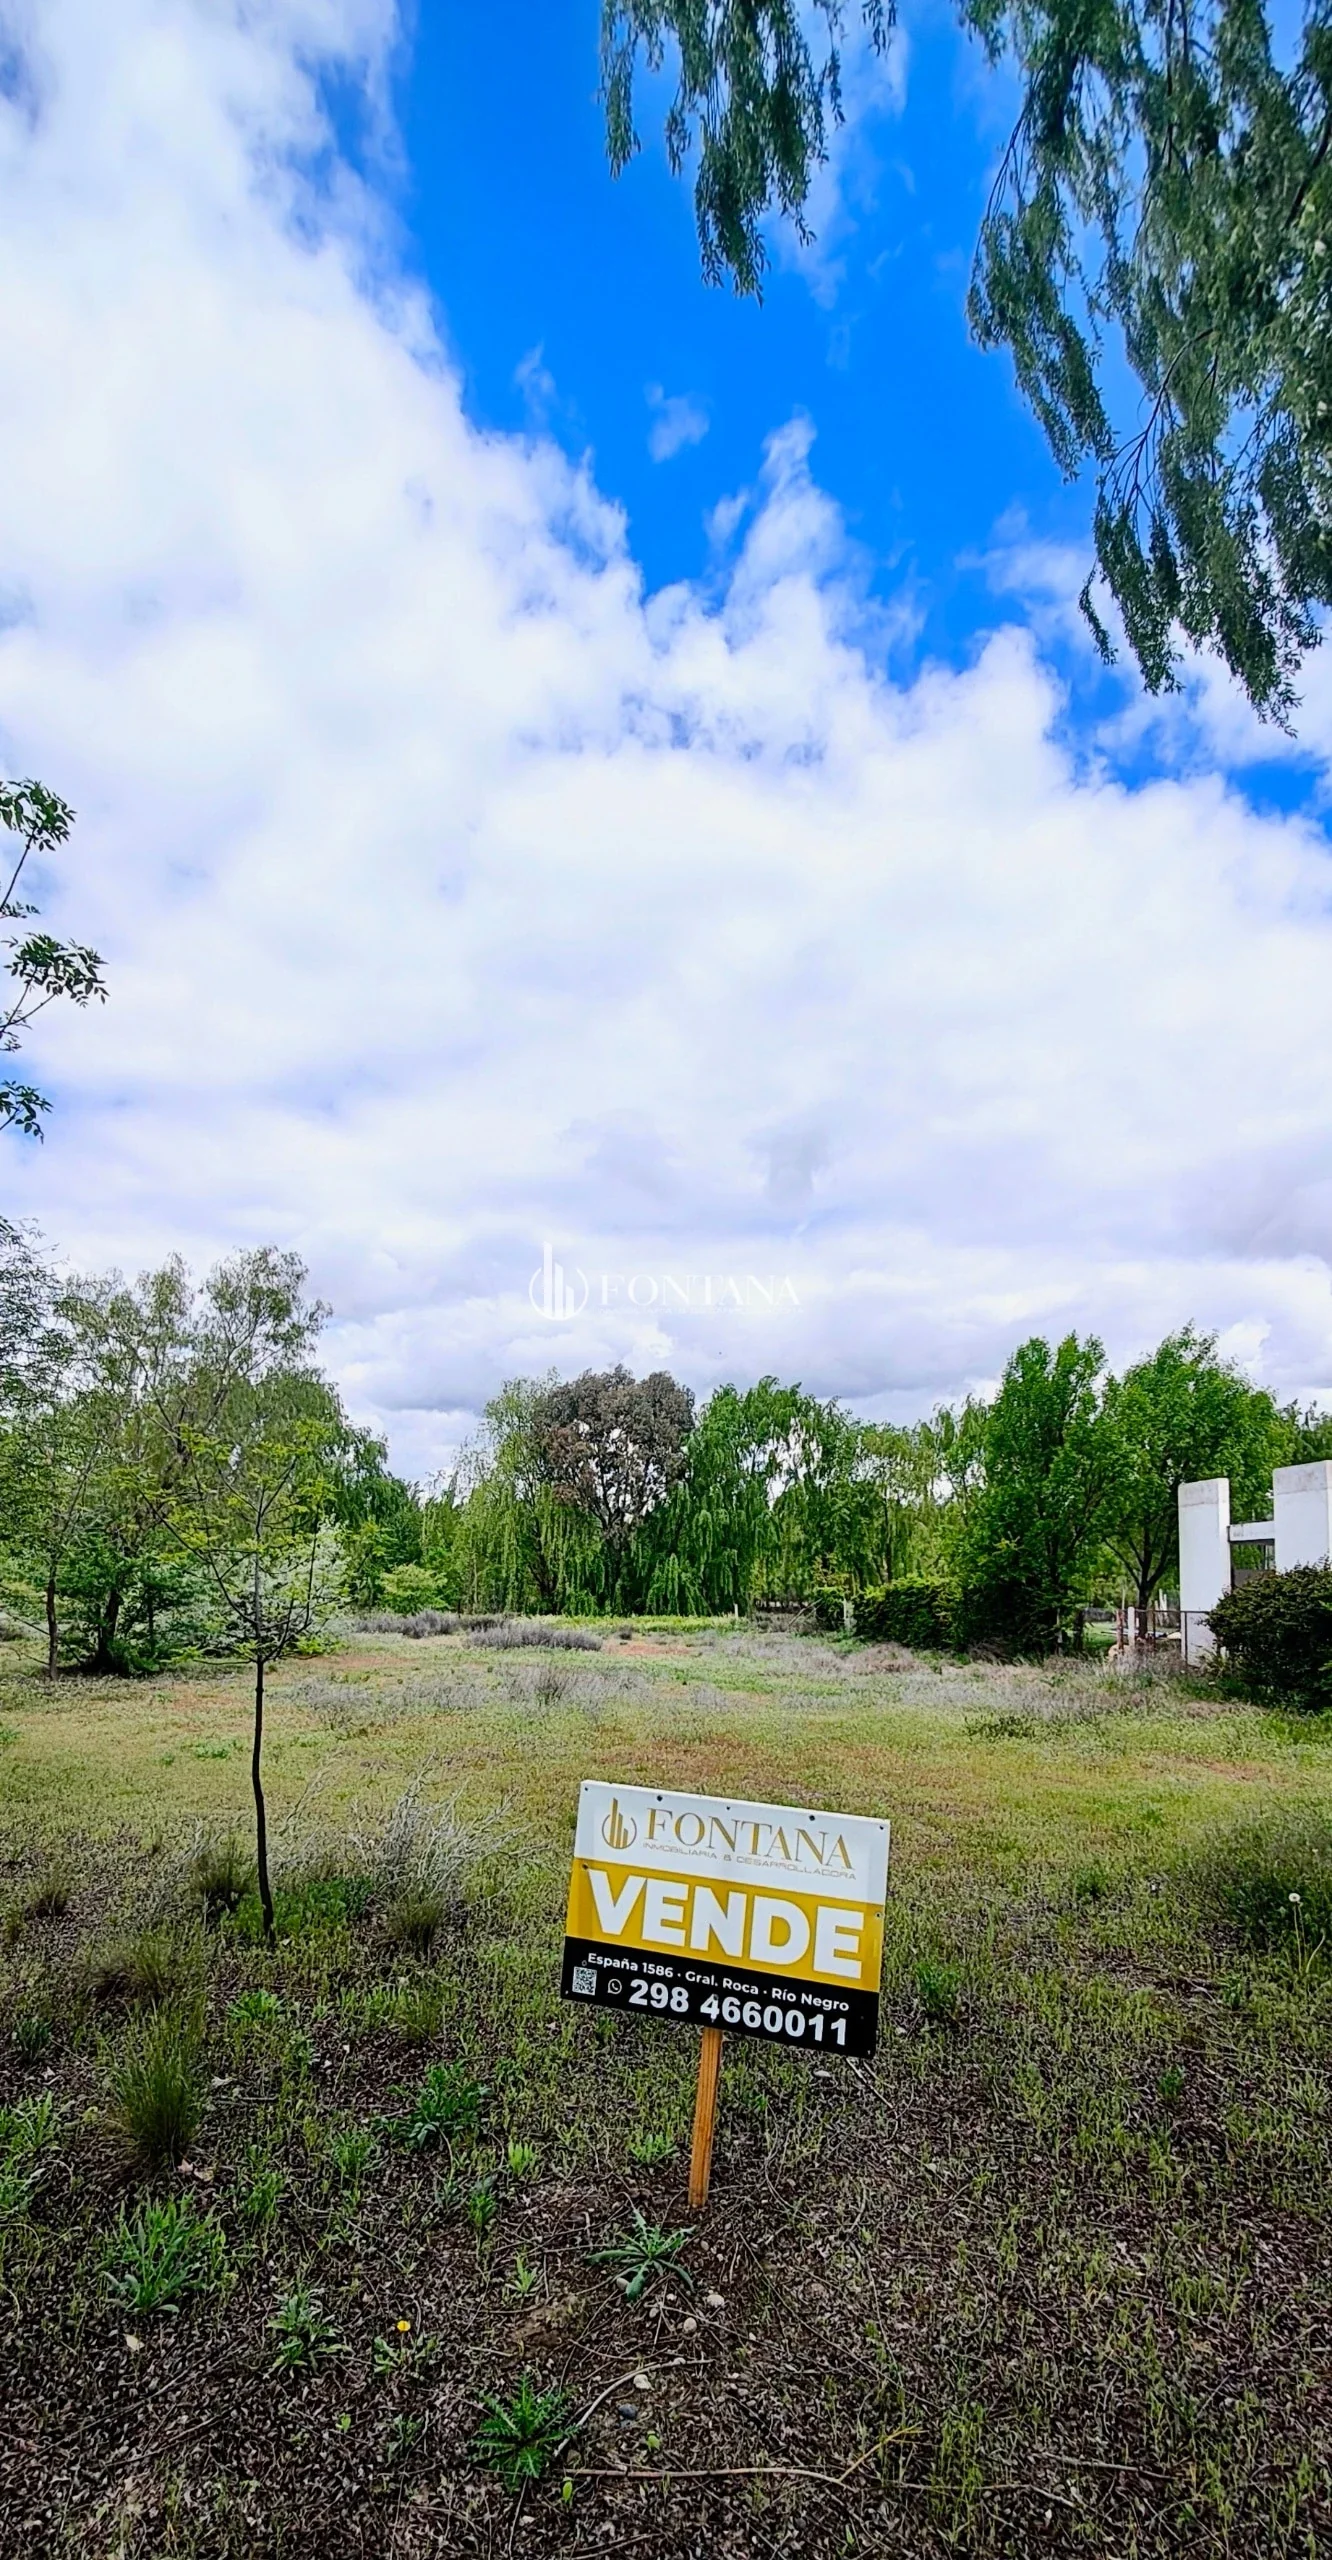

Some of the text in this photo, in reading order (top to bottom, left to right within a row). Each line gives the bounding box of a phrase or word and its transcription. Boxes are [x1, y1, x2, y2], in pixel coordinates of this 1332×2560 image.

[642, 1842, 717, 1861] INMOBILIARIA
[646, 1807, 855, 1870] FONTANA
[587, 1868, 864, 1979] VENDE
[587, 1953, 638, 1972] España
[642, 1962, 674, 1978] 1586
[685, 1970, 718, 1987] Gral.
[722, 1978, 759, 1996] Roca
[771, 1988, 797, 2002] Río
[801, 1993, 849, 2012] Negro
[628, 1979, 848, 2046] 298 4660011
